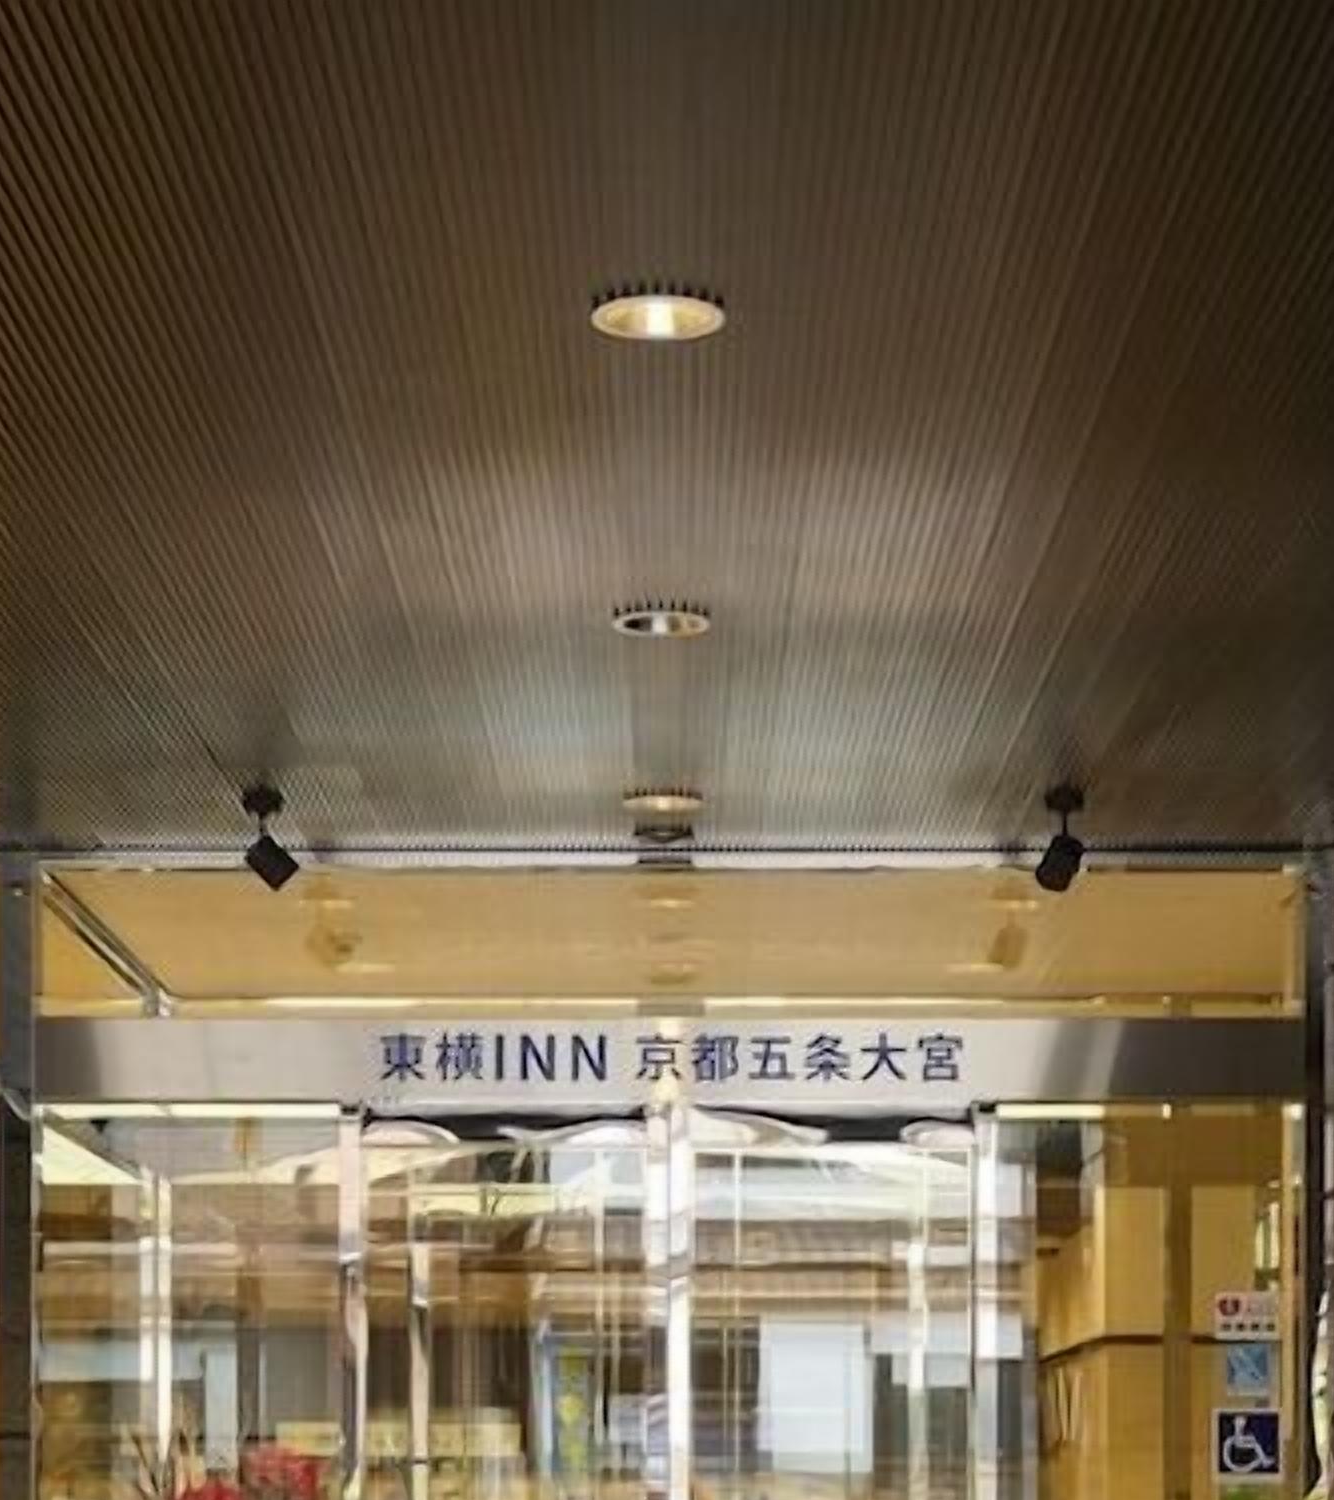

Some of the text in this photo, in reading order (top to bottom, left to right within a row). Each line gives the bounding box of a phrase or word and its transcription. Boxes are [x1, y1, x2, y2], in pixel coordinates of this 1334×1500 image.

[380, 1032, 963, 1082] 東横INN 京都五条大宮
